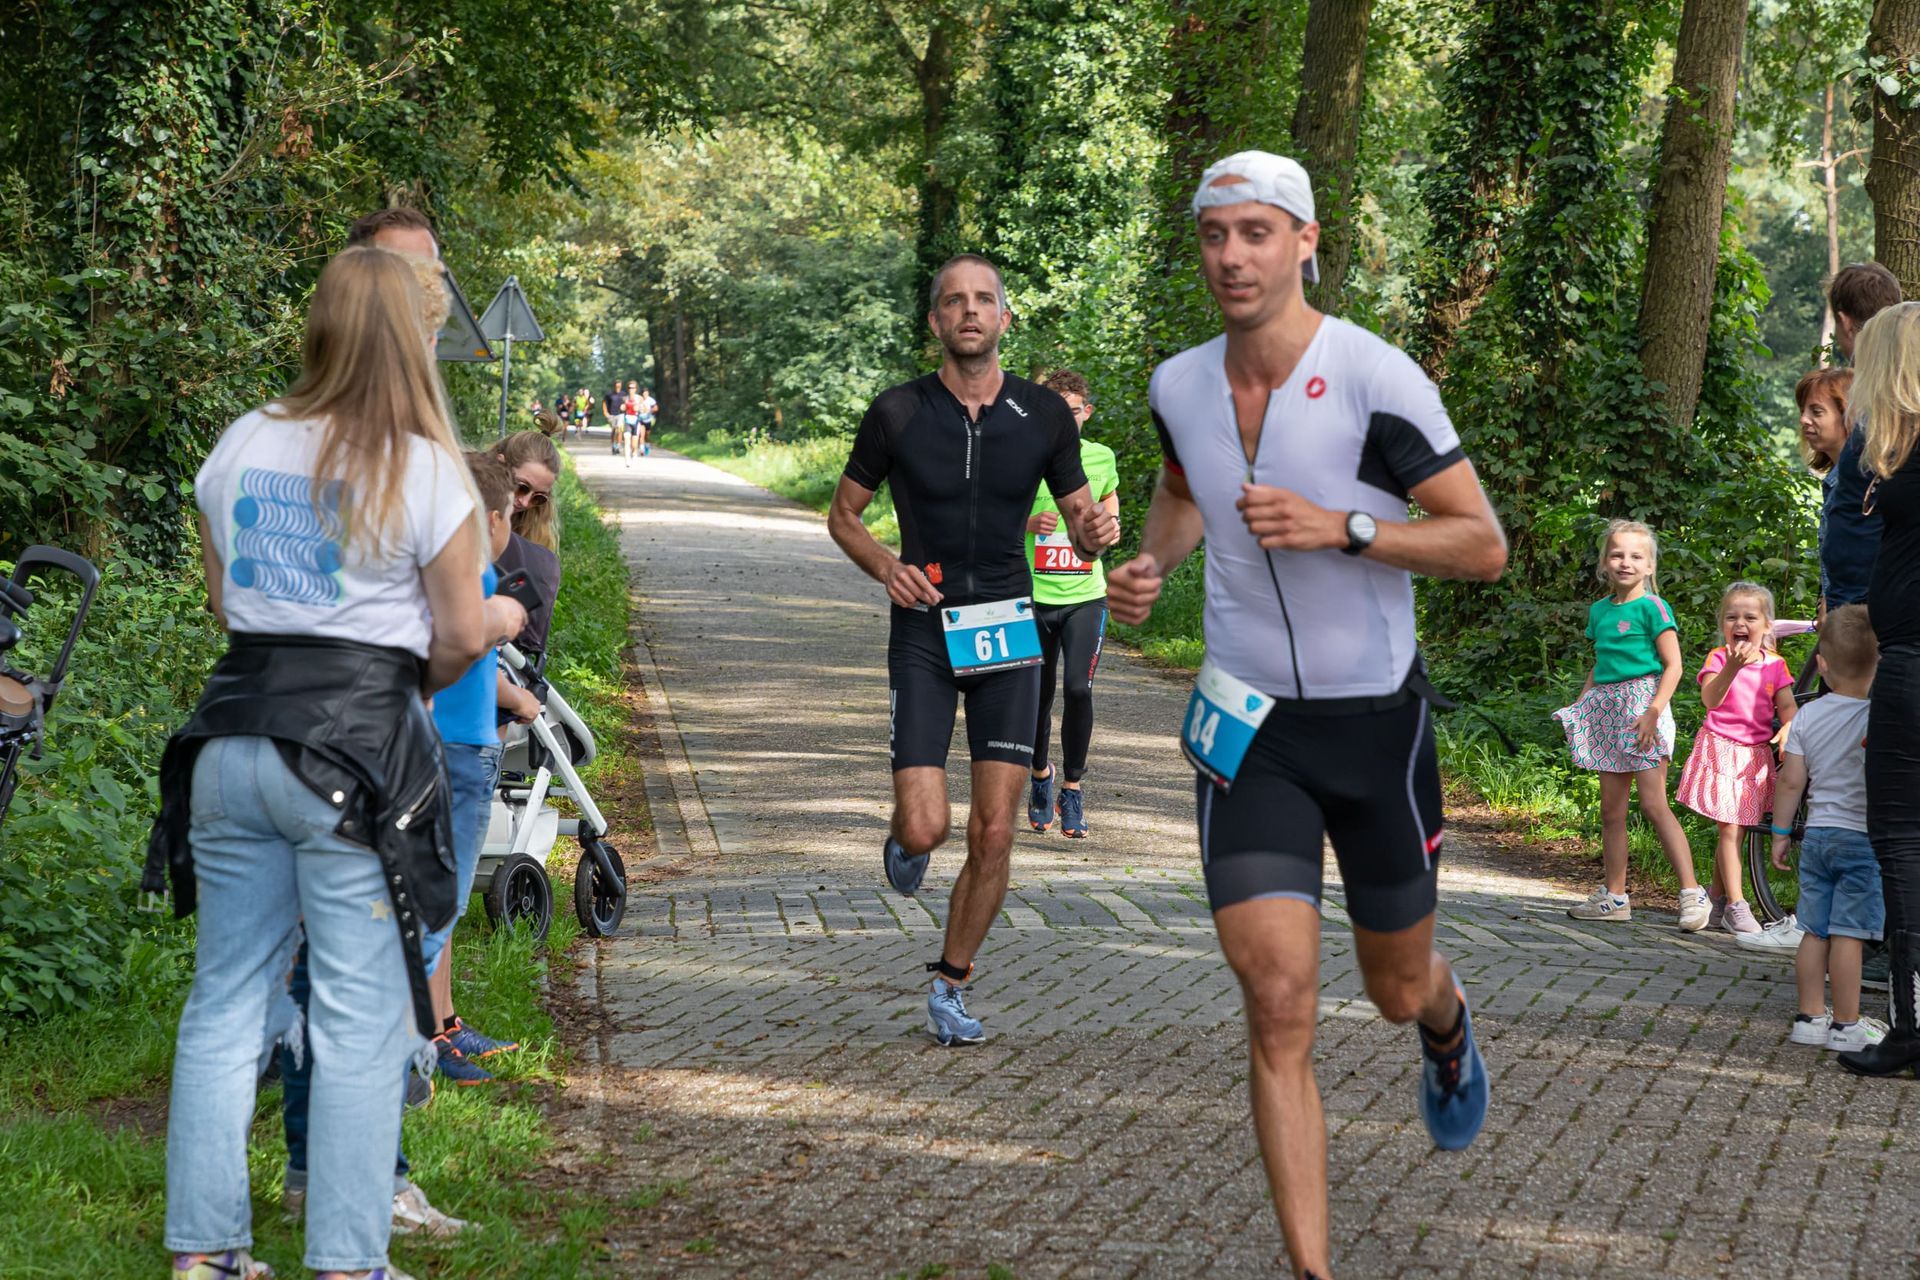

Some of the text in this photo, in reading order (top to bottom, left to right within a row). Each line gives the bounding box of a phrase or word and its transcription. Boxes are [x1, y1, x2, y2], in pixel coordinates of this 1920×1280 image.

[974, 627, 1010, 662] 61
[1190, 698, 1221, 756] 84
[987, 740, 1015, 751] HUMAN
[1600, 903, 1611, 913] N
